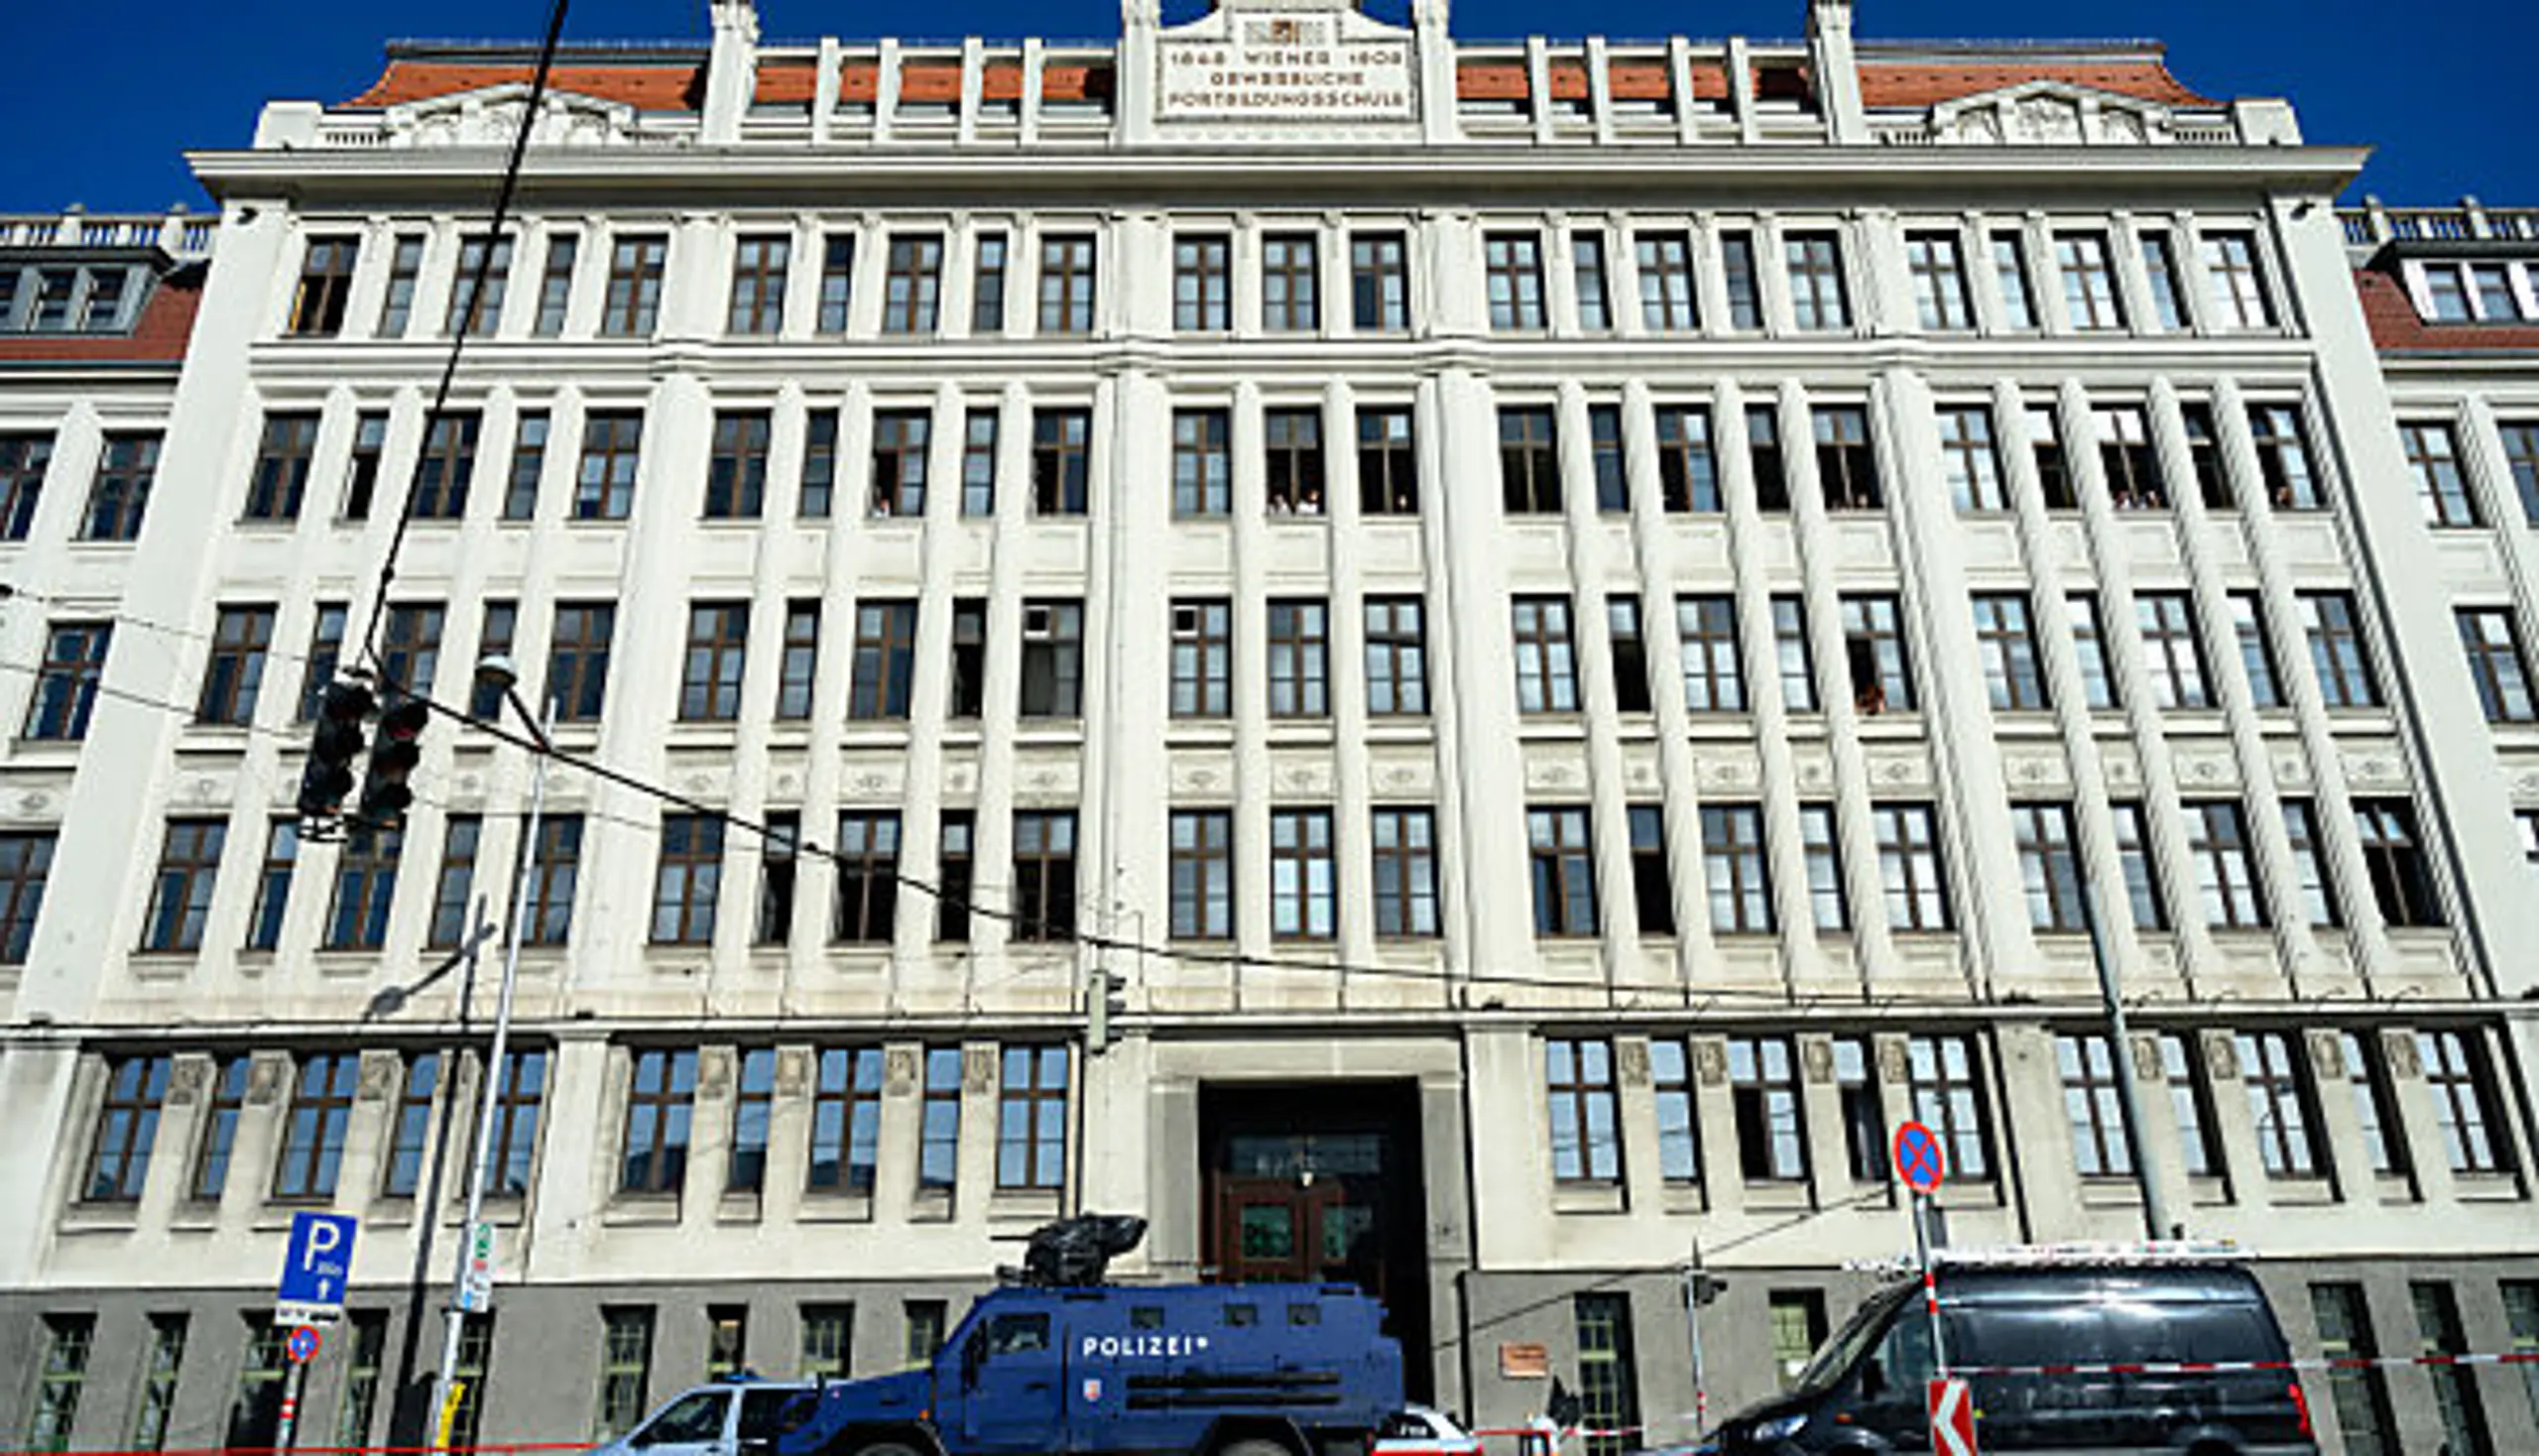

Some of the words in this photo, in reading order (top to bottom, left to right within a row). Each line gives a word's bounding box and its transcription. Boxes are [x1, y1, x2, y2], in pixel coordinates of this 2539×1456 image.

[1243, 51, 1330, 66] WIENER
[303, 1219, 340, 1271] P
[1082, 1336, 1191, 1357] POLIZEI
